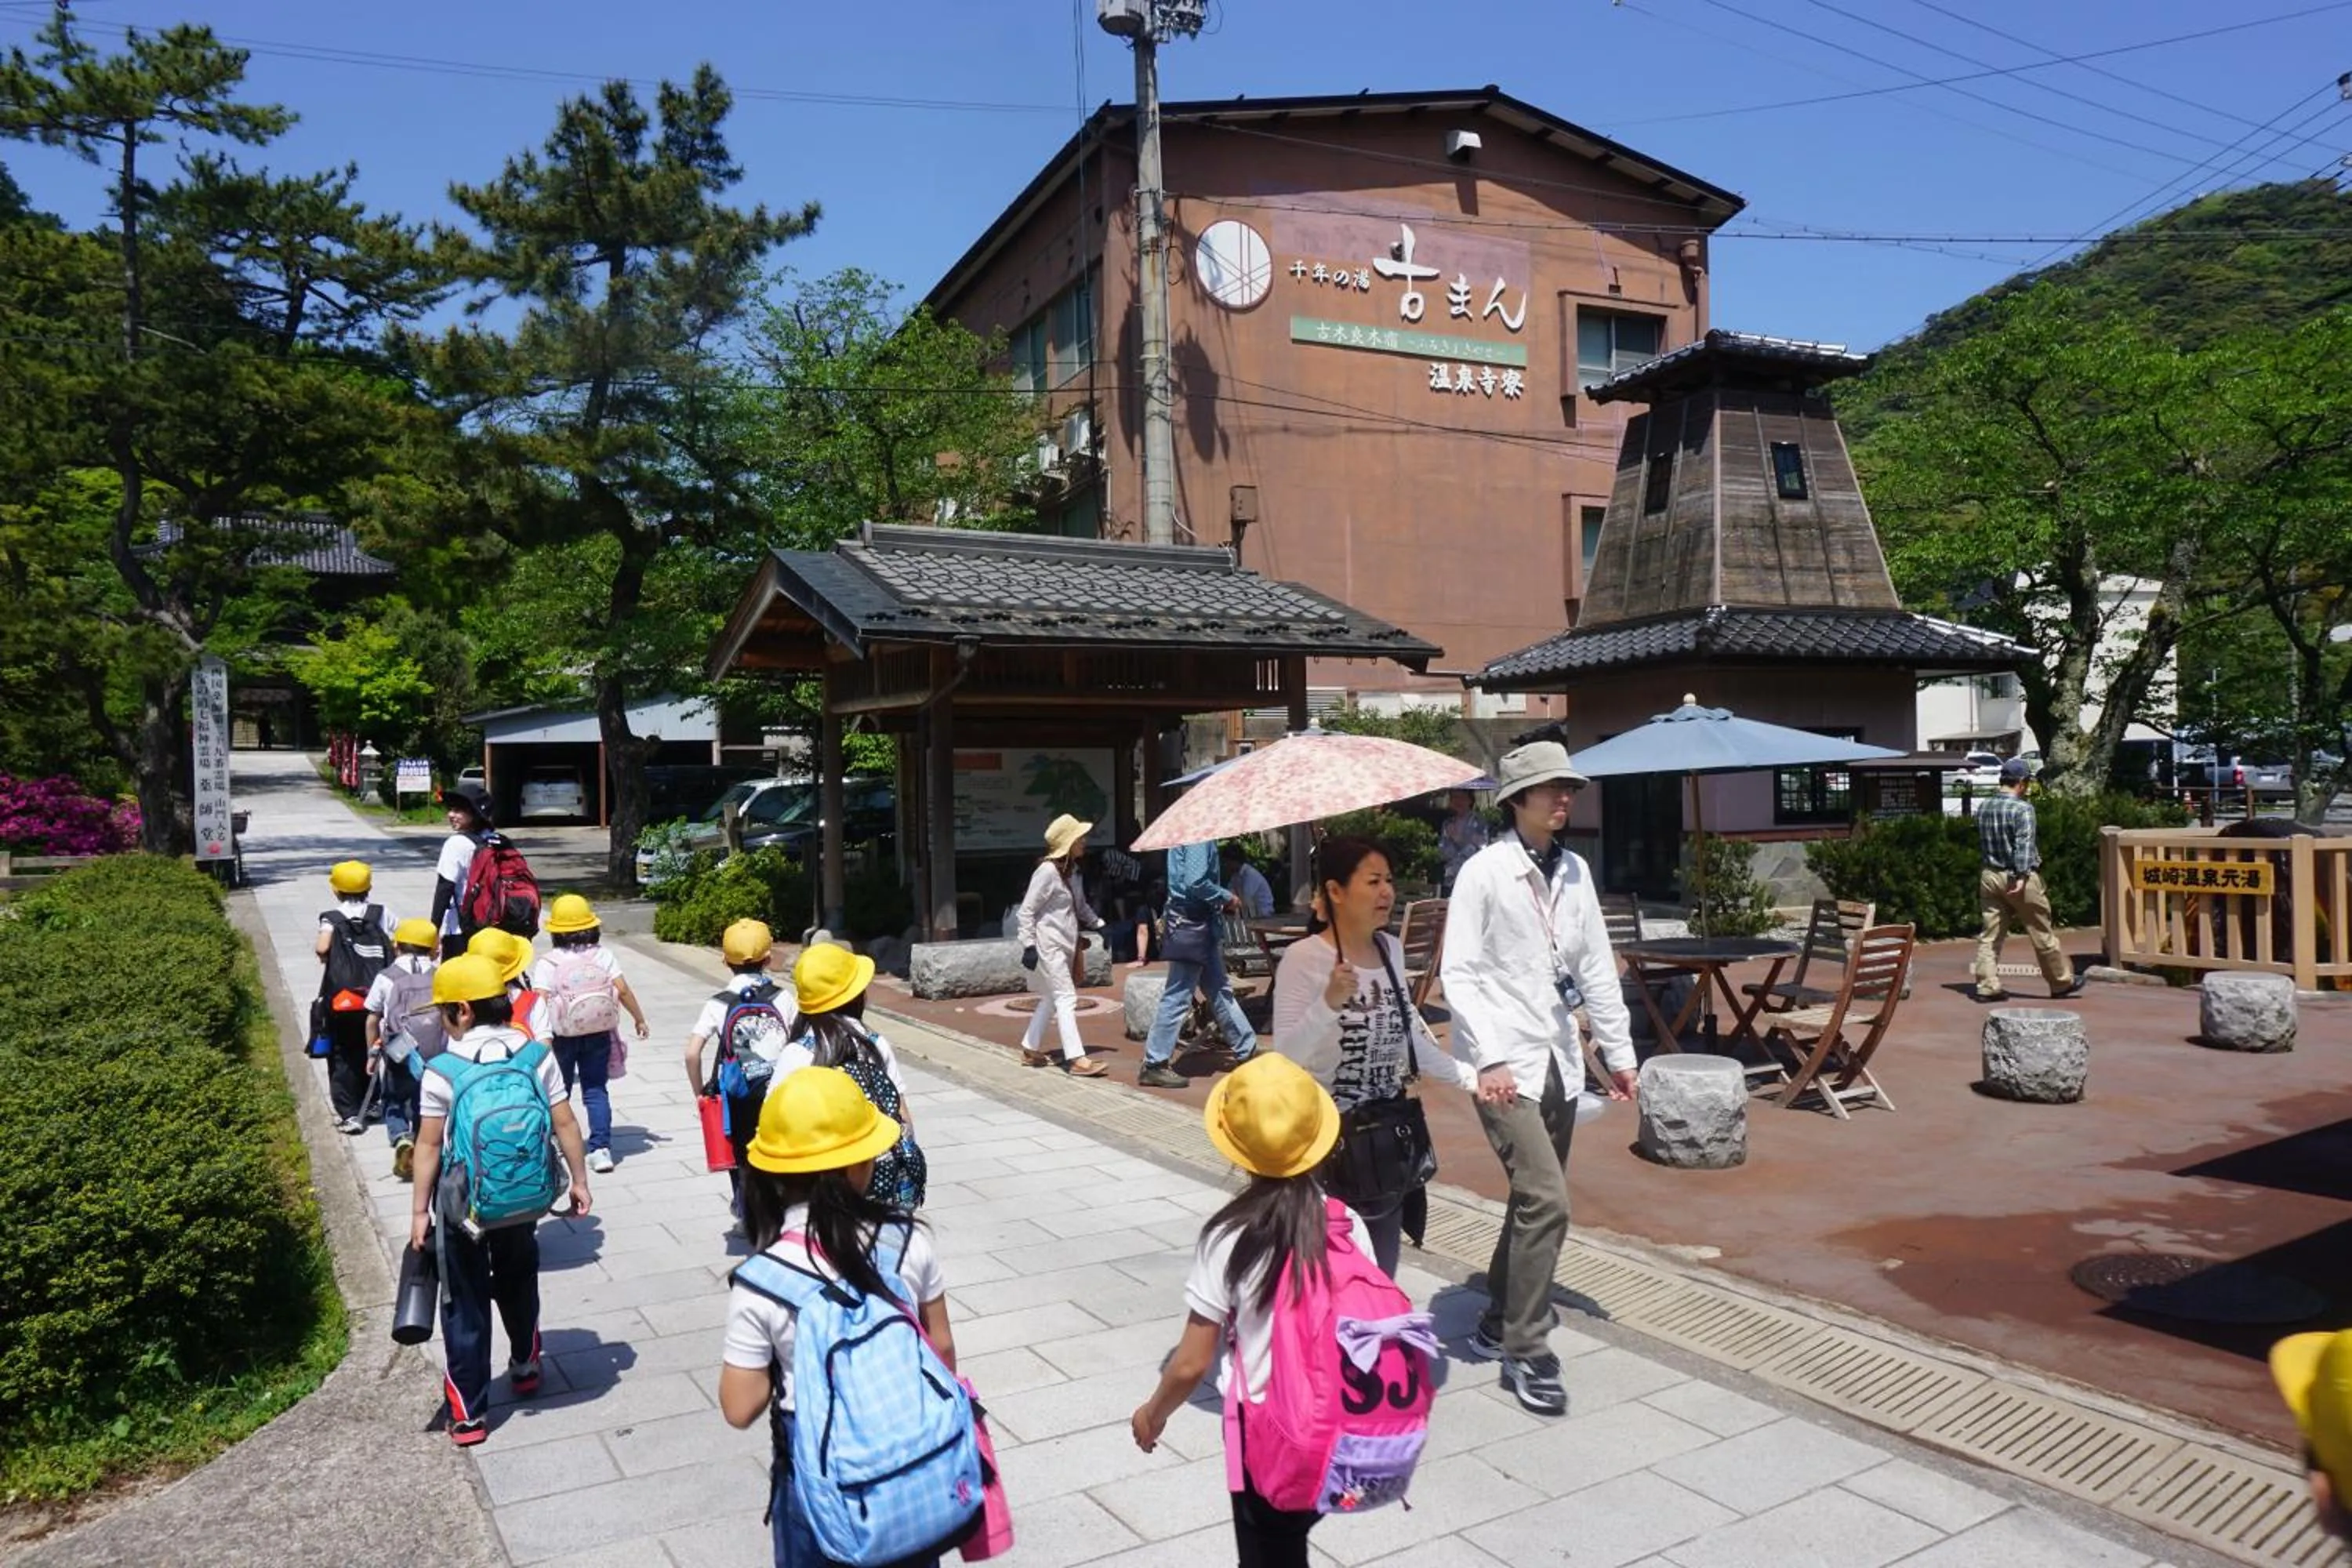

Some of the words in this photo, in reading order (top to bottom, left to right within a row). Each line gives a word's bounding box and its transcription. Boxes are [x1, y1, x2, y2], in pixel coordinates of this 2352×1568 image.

[1289, 260, 1370, 289] 千年の湯
[2143, 866, 2260, 888] 城崎温泉元湯
